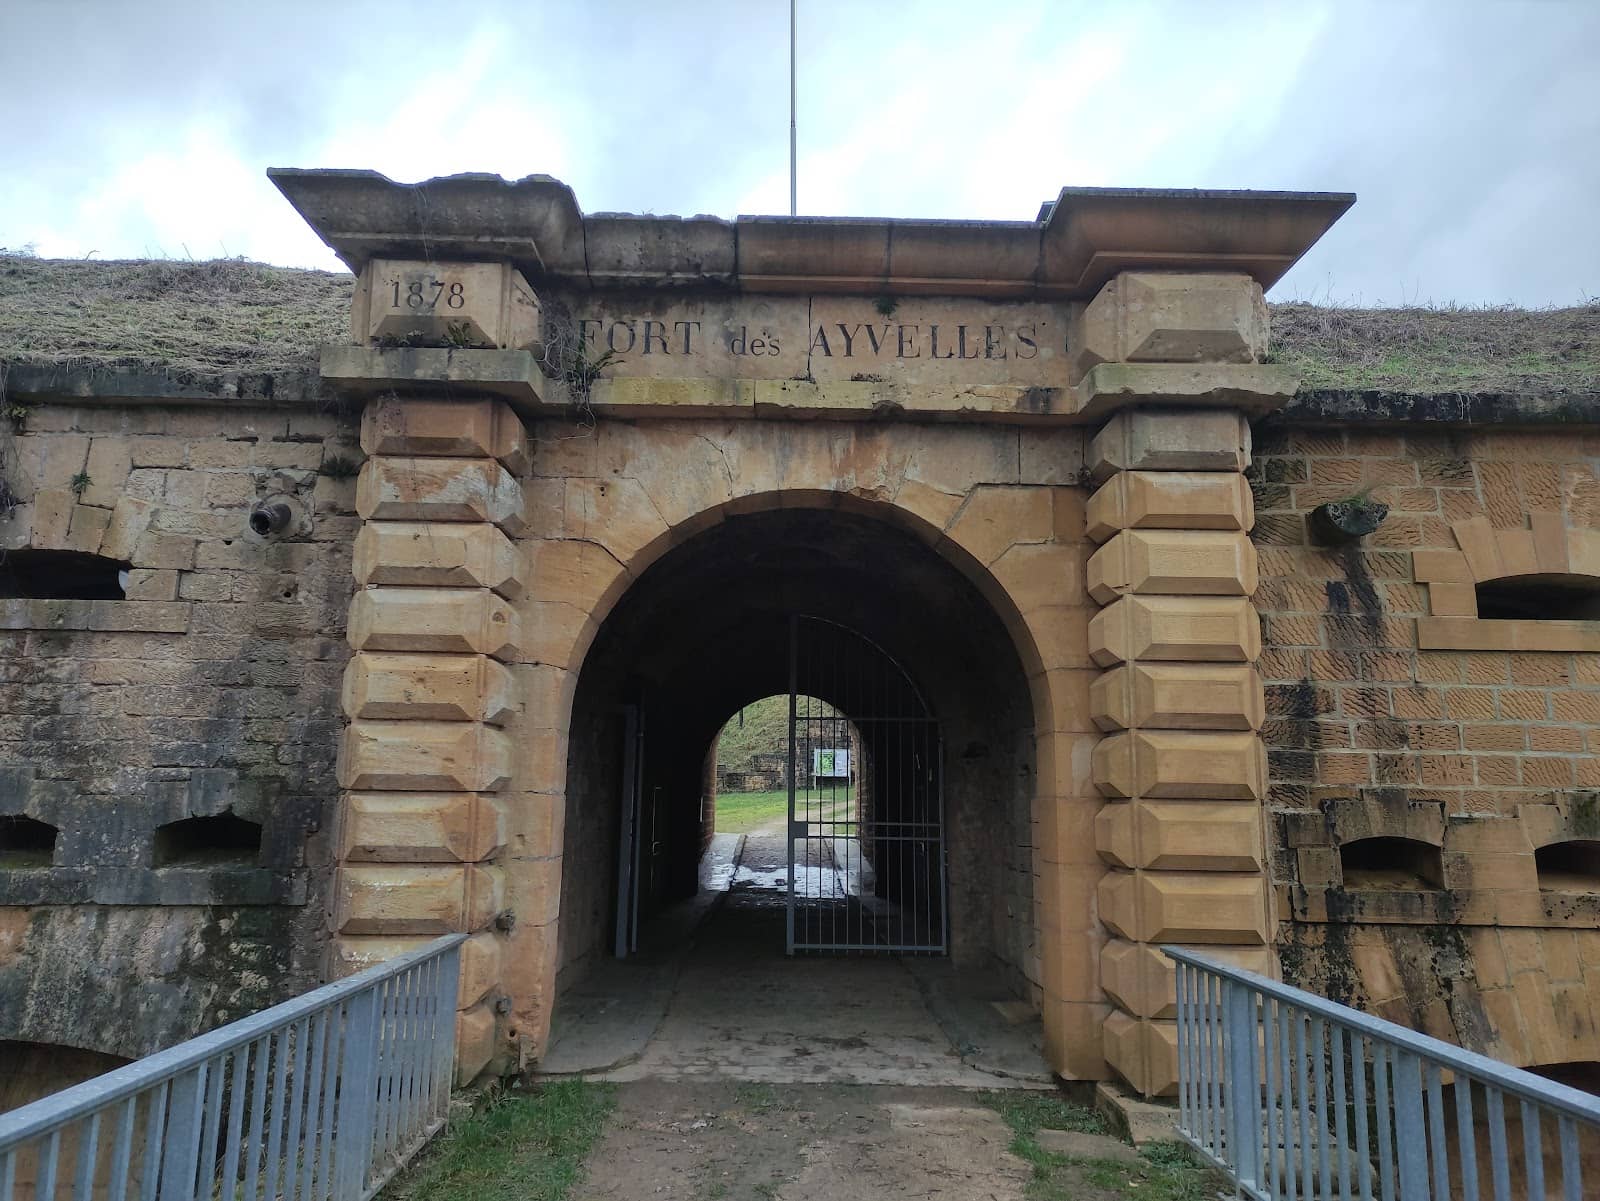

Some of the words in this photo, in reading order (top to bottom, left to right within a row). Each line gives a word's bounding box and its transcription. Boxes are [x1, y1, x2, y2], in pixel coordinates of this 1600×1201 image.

[391, 280, 465, 309] 1878
[580, 319, 701, 355] FORT
[731, 326, 781, 357] des
[810, 323, 1039, 360] AYVELLES
